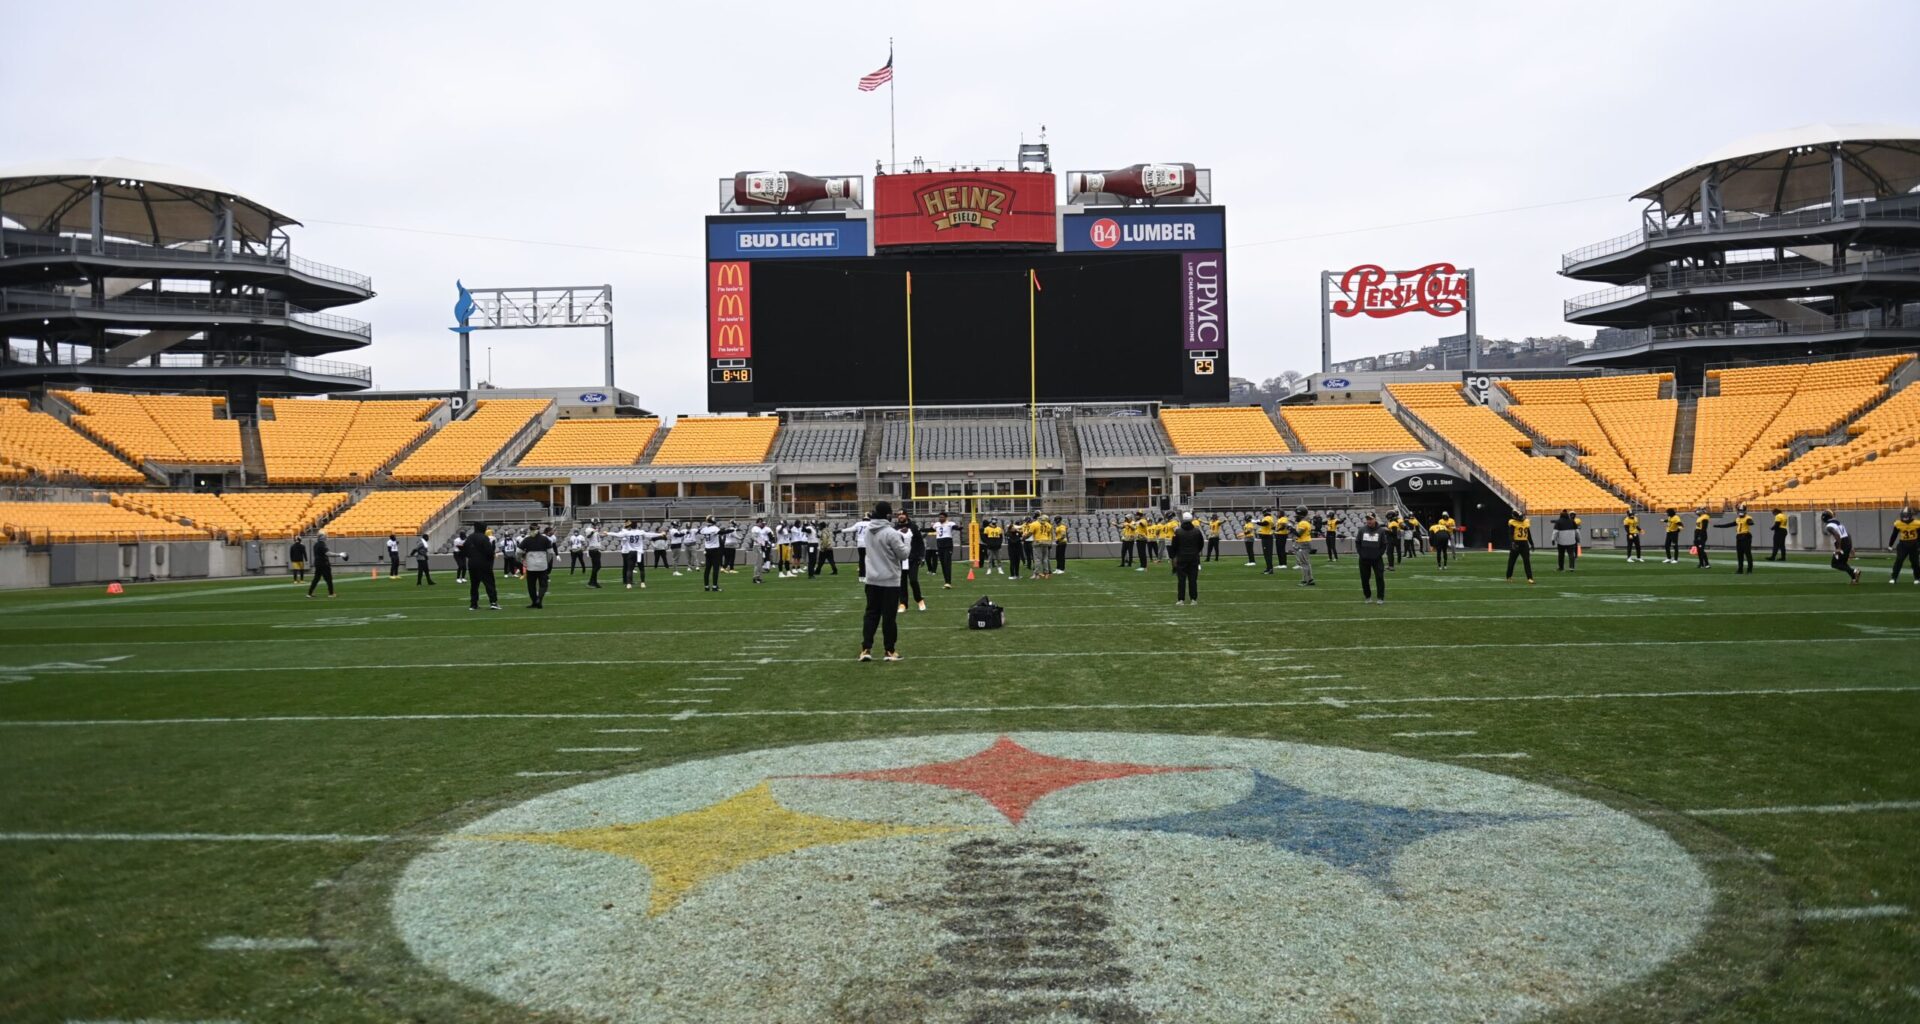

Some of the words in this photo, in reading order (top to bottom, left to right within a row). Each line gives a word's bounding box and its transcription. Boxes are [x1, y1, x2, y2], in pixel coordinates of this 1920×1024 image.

[922, 186, 1006, 216] HEINZ
[953, 211, 978, 222] FIELD
[739, 233, 779, 248] BUD
[781, 232, 835, 247] LIGHT
[1094, 225, 1117, 242] 84
[1123, 223, 1196, 242] LUMBER
[1196, 260, 1219, 342] UPMC
[483, 299, 613, 327] PEOPLES
[1197, 361, 1213, 373] 25
[723, 370, 748, 381] 8:48
[1903, 530, 1916, 539] 35
